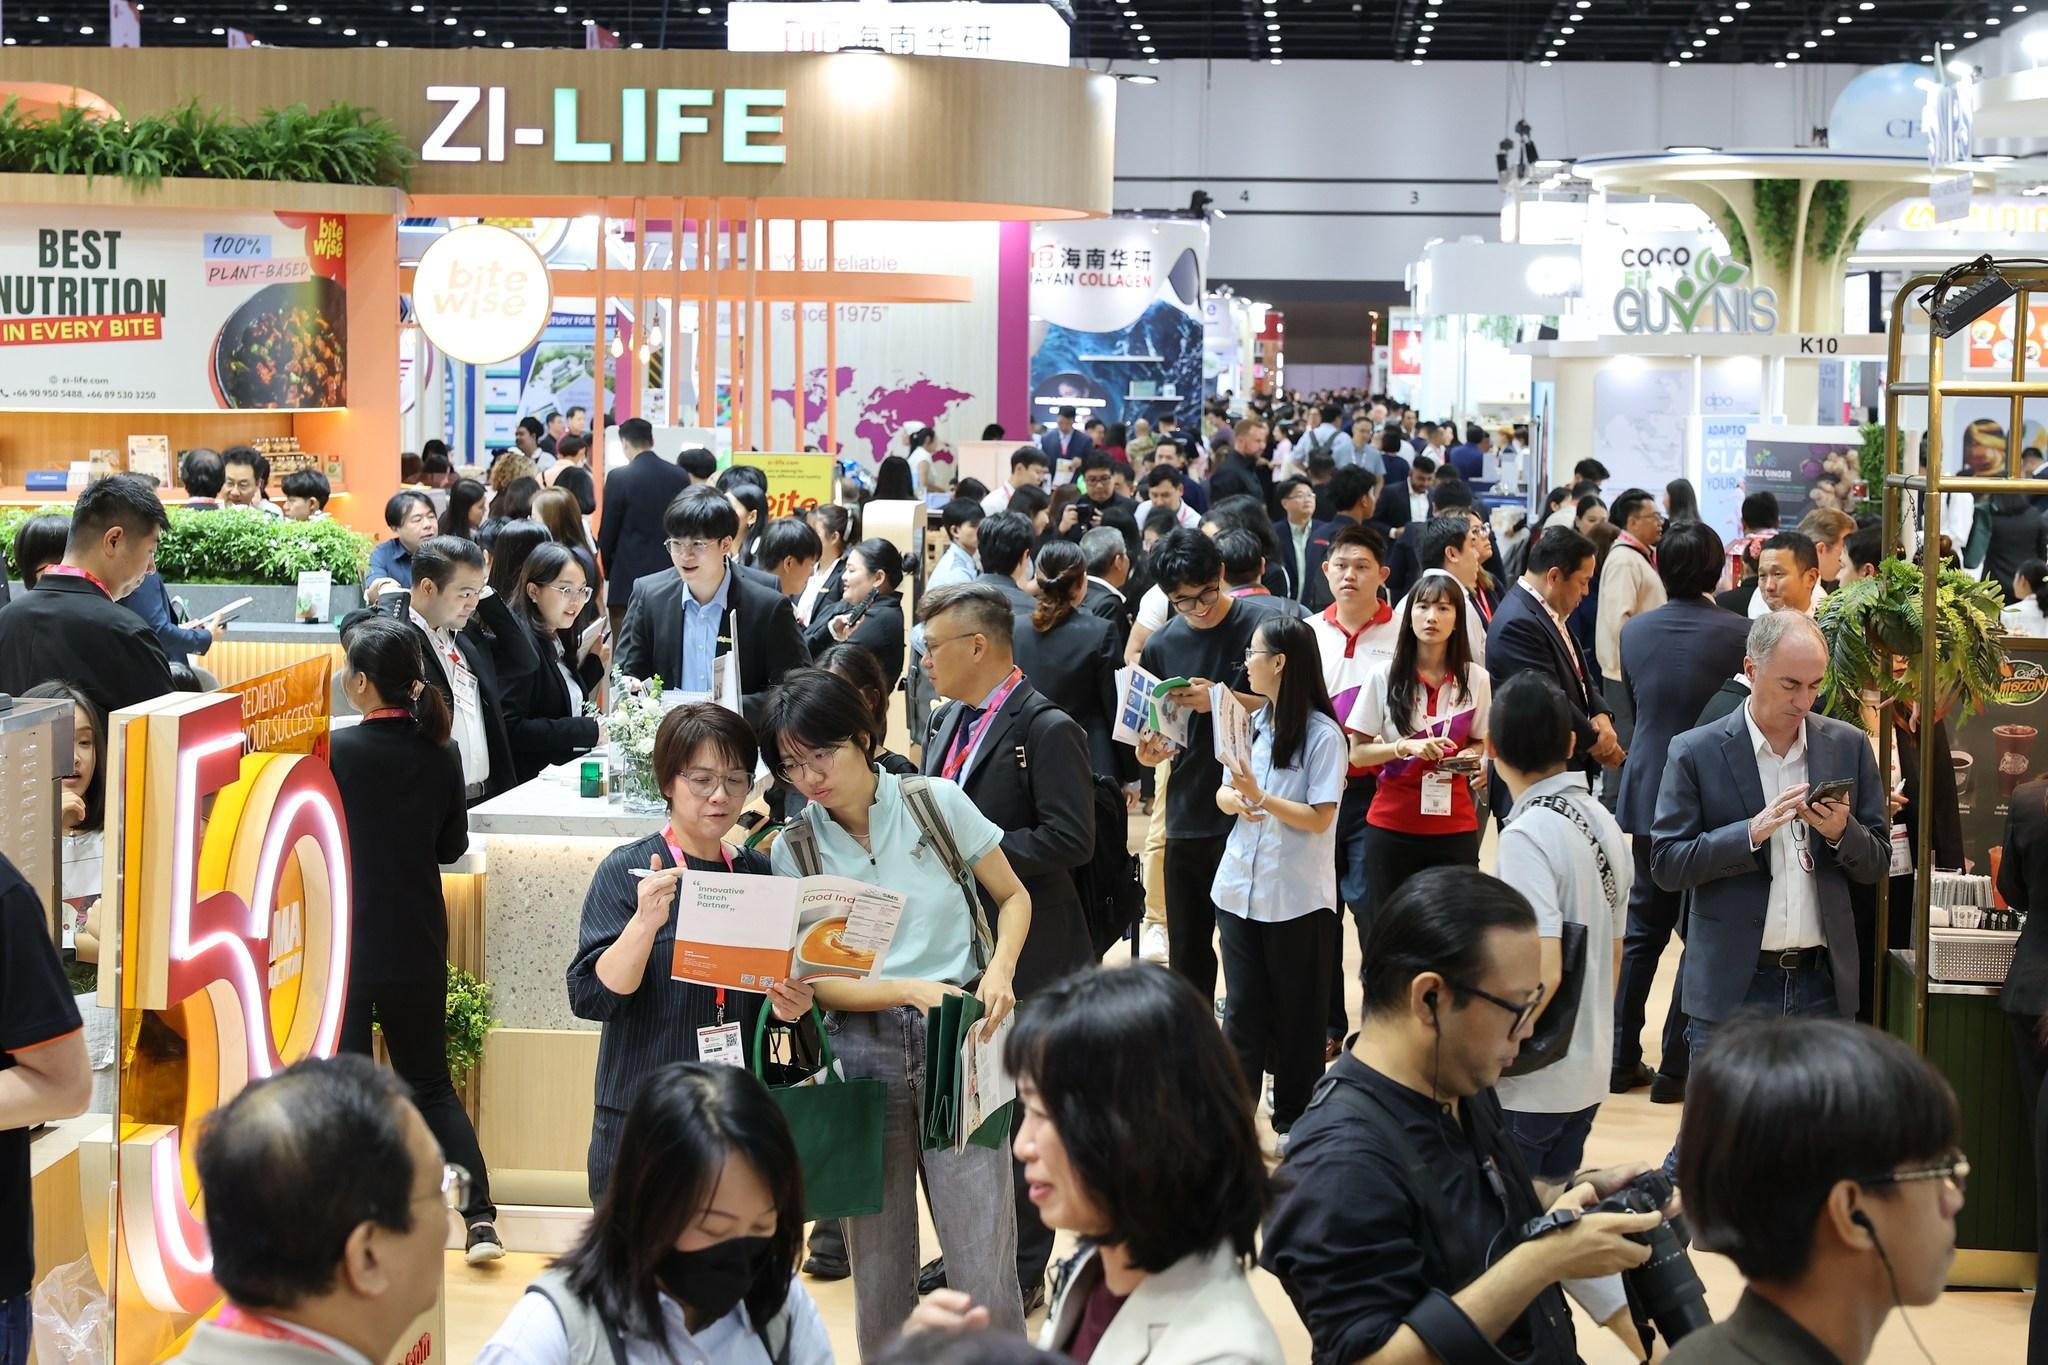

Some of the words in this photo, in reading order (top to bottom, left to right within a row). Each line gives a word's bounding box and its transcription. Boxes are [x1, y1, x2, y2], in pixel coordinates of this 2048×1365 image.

[421, 86, 787, 164] ZI-LIFE
[1240, 189, 1249, 202] 4
[1410, 190, 1419, 205] 3
[319, 216, 344, 242] bite
[38, 228, 122, 270] BEST
[213, 235, 261, 255] 100%
[313, 238, 343, 260] wise
[1061, 247, 1151, 271] 海南华研
[1621, 247, 1690, 268] COCO
[209, 261, 309, 282] PLANT-BASED
[448, 259, 529, 293] bite
[1078, 272, 1151, 288] COLLAGEN
[0, 274, 167, 318] NUTRITION
[433, 289, 527, 320] wise
[3, 325, 26, 342] IN
[30, 319, 104, 341] EVERY
[110, 318, 156, 337] BITE
[1800, 337, 1838, 354] K10
[62, 376, 109, 385] zi-life.com
[697, 893, 728, 902] Starch
[803, 893, 833, 905] Food
